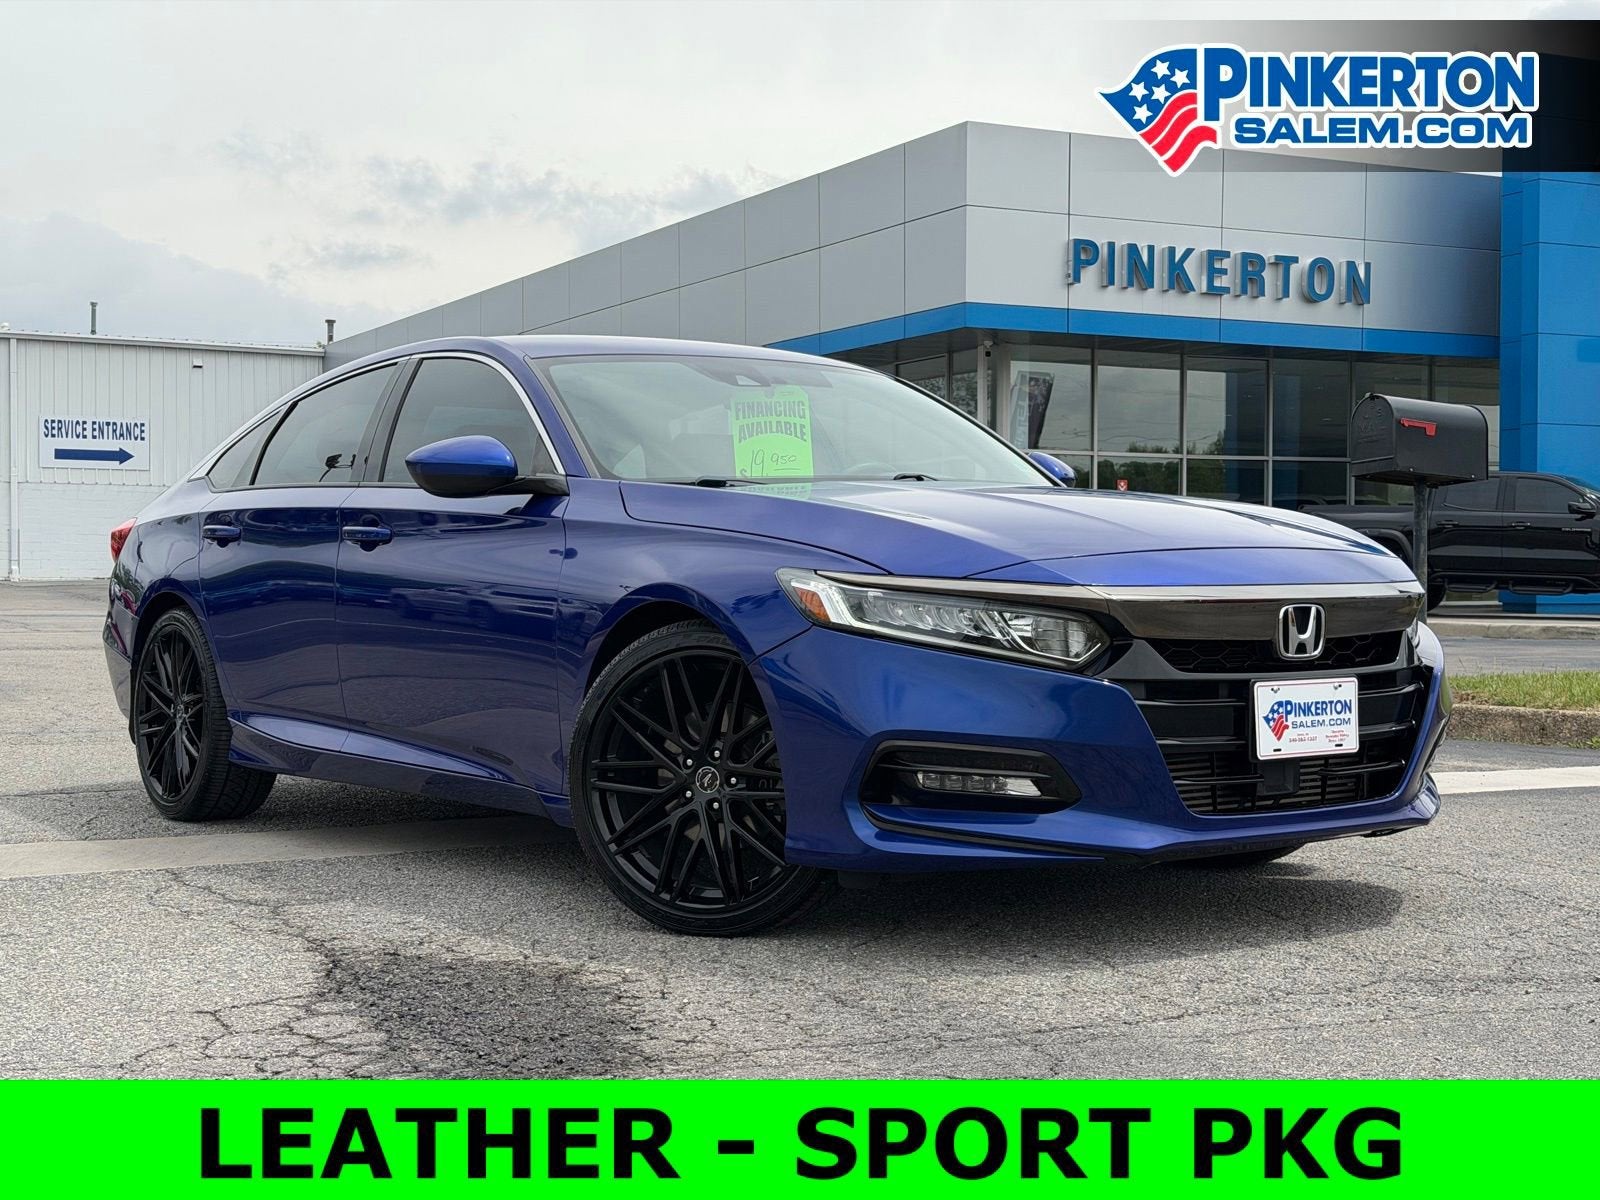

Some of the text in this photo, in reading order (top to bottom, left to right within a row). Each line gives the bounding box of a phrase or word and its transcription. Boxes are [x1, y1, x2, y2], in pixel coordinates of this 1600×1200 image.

[1068, 237, 1372, 305] PINKERTON
[735, 400, 806, 421] FINANCING
[43, 418, 146, 441] SERVICE ENTRANCE
[738, 420, 807, 443] AVAILABLE
[1284, 699, 1352, 722] PINKERTON
[1291, 717, 1351, 729] SALEM.COM
